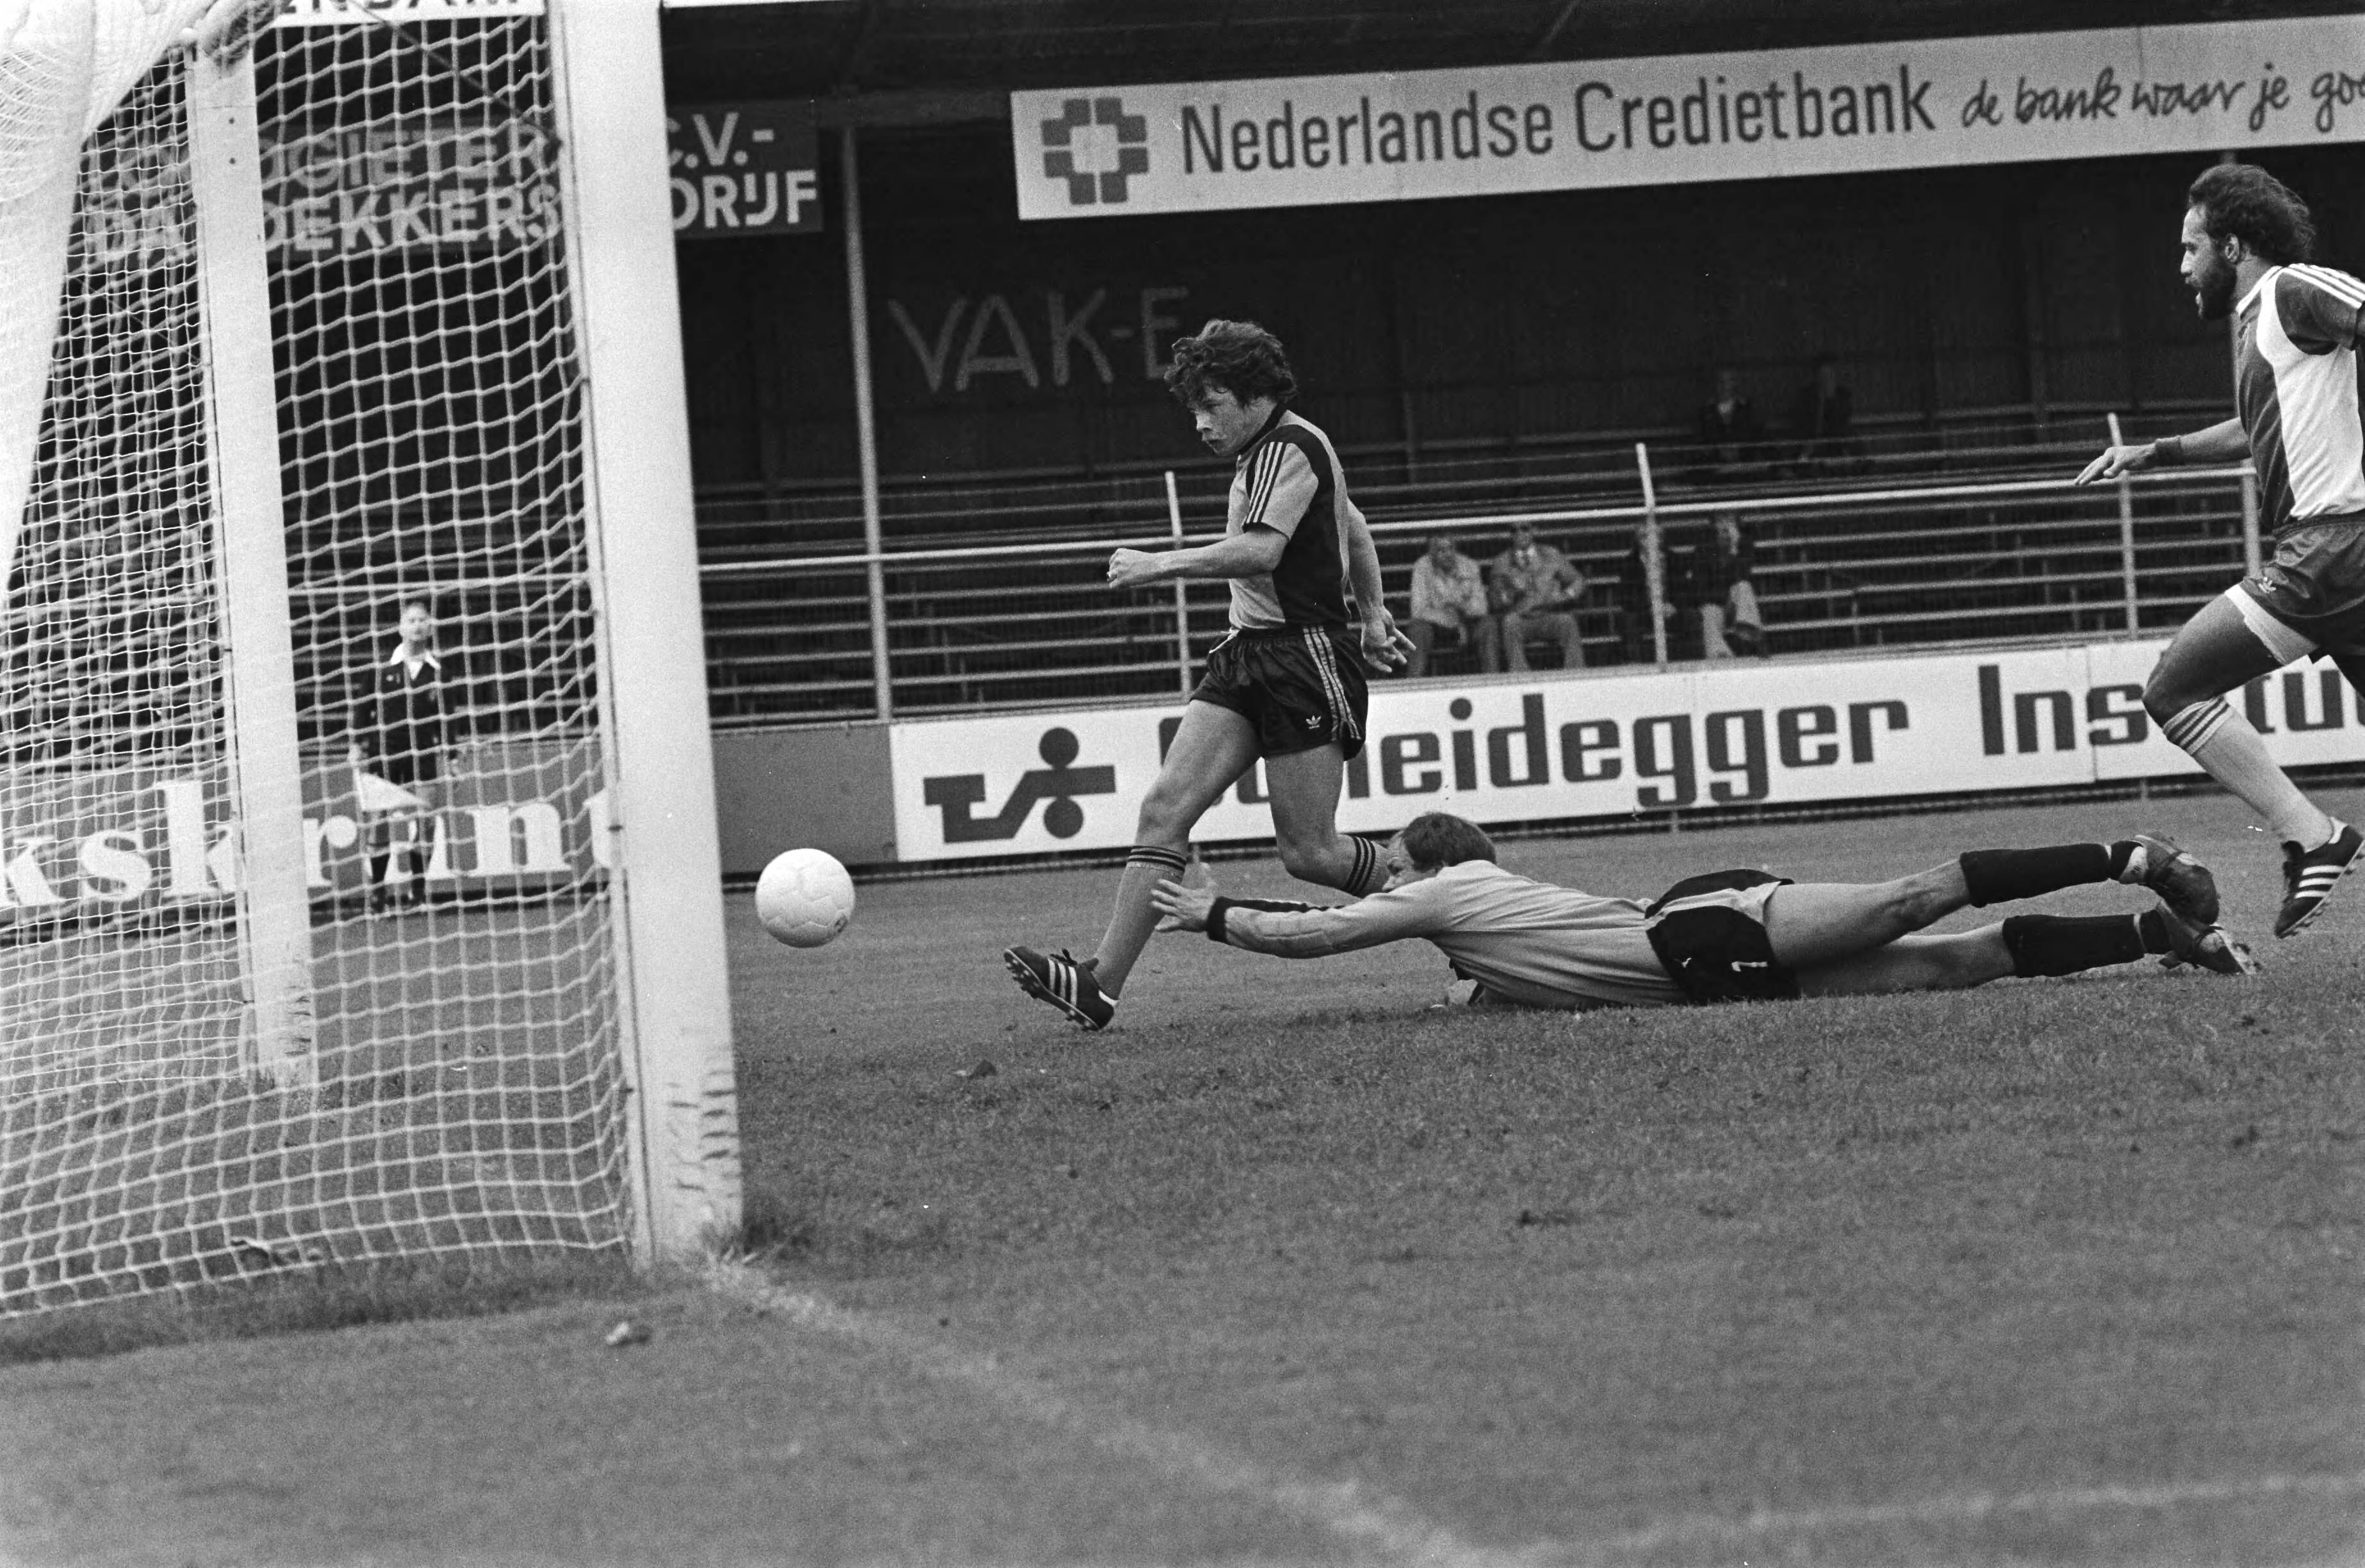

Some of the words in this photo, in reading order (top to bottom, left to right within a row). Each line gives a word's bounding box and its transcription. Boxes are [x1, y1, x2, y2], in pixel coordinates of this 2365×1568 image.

[1181, 90, 1553, 175] Nederlandse
[1575, 64, 1936, 152] Credietbank
[1962, 78, 2004, 127] de
[2016, 66, 2122, 125] bank
[2132, 81, 2246, 117] waar
[2249, 63, 2291, 132] je
